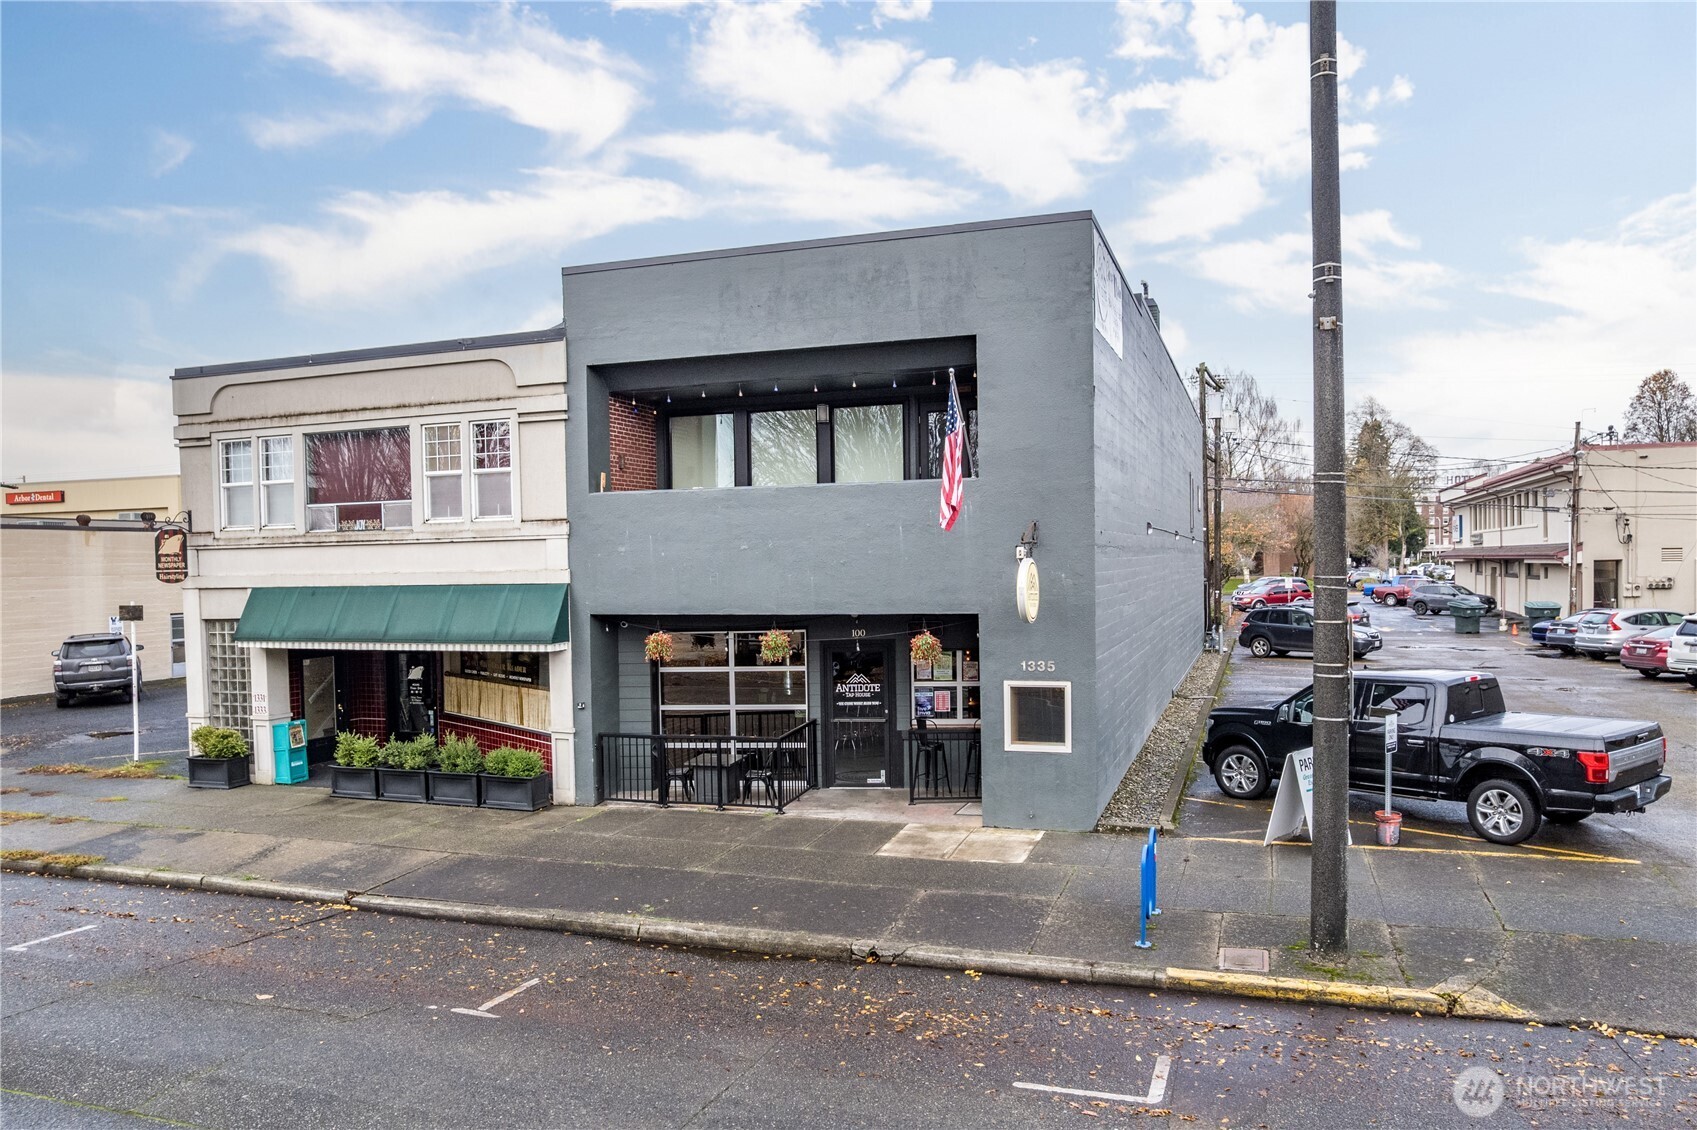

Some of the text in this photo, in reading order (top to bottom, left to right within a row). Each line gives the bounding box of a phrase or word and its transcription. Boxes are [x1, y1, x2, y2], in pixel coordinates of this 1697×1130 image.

[14, 492, 54, 502] Arbor Dental
[354, 519, 366, 530] JOY
[851, 628, 866, 637] 100
[1020, 660, 1056, 672] 1335
[835, 683, 881, 693] ANTIDOTE
[253, 693, 266, 702] 1331
[254, 705, 268, 714] 1333
